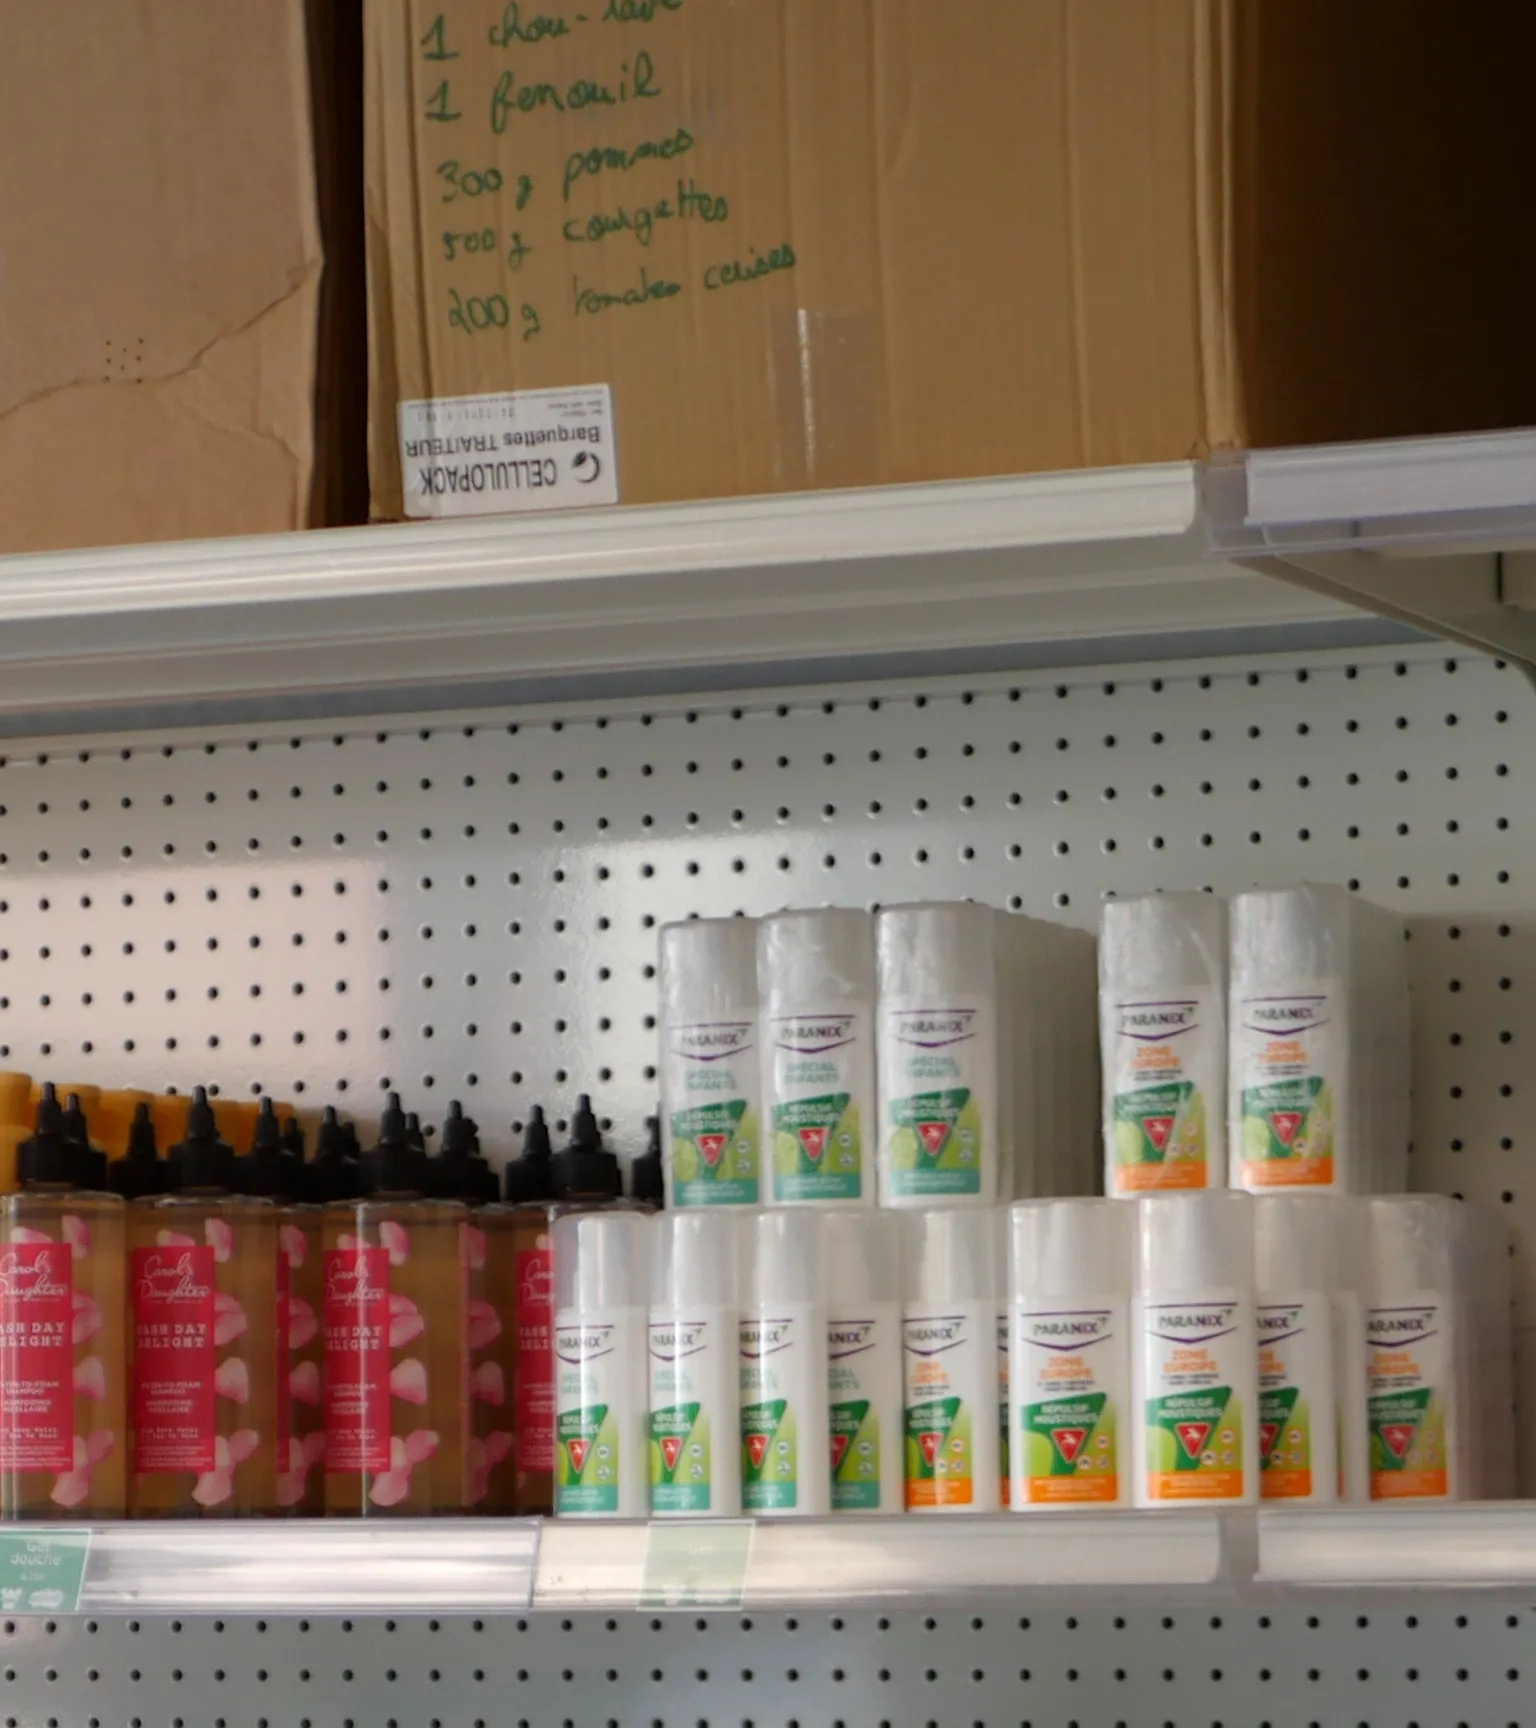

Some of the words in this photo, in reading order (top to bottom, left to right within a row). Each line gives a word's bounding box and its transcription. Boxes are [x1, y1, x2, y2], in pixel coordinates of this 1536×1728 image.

[437, 160, 503, 202] 300
[503, 425, 601, 448] Barquettes
[405, 435, 498, 457] TRAITEUR
[421, 458, 557, 494] CELLULOPACK
[31, 1322, 65, 1334] DAY
[1158, 1314, 1224, 1328] PARANIX
[1368, 1318, 1424, 1331] ARANIX
[174, 1323, 207, 1336] DAY
[352, 1325, 382, 1338] DAY
[1033, 1322, 1099, 1336] PARANIX
[10, 1552, 62, 1567] douche
